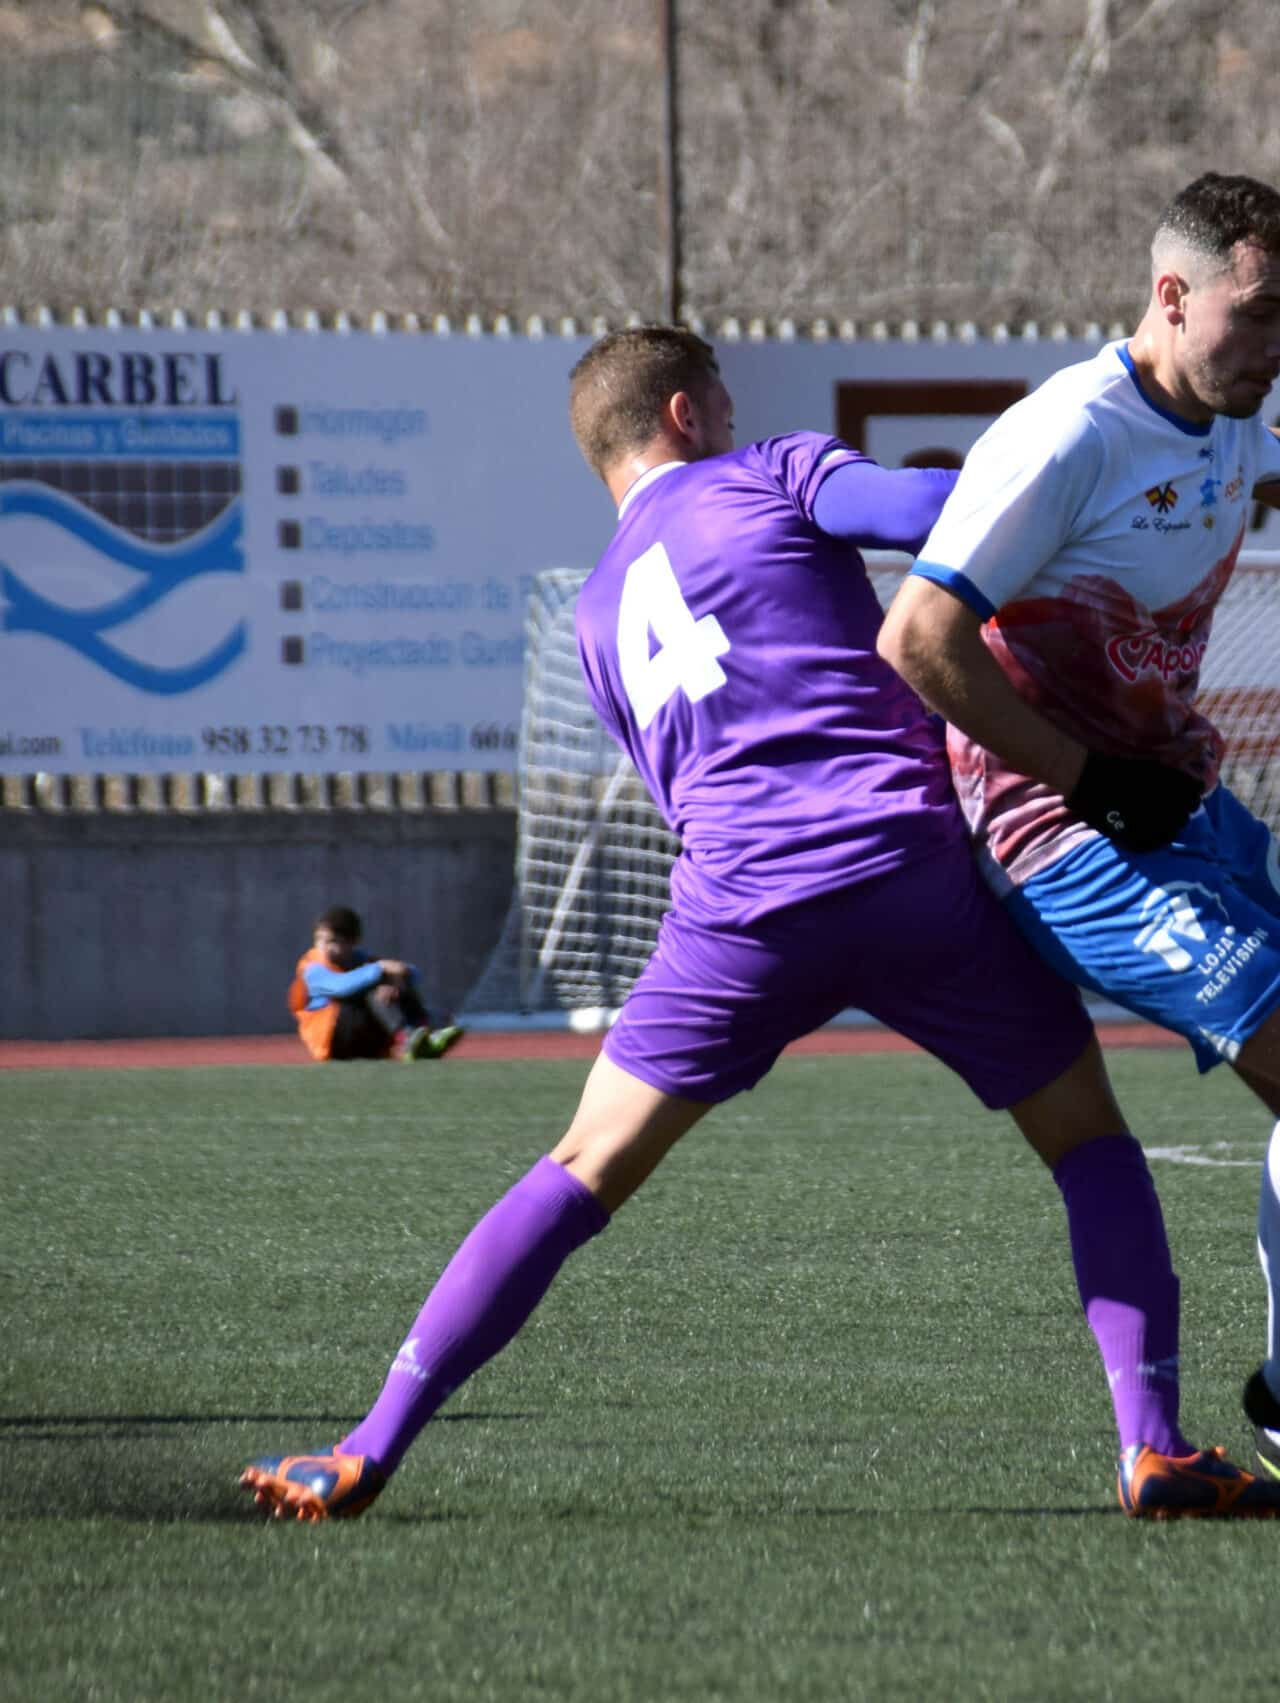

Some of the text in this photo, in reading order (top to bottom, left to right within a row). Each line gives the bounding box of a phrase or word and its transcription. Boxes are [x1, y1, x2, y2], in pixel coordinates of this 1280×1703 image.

[307, 464, 407, 497] Taludes
[617, 541, 731, 731] 4
[200, 724, 250, 755] 958
[256, 724, 290, 755] 32
[298, 724, 330, 754] 73
[336, 724, 369, 754] 78
[1194, 926, 1270, 1006] TELEVISION
[1196, 936, 1235, 976] LOJA
